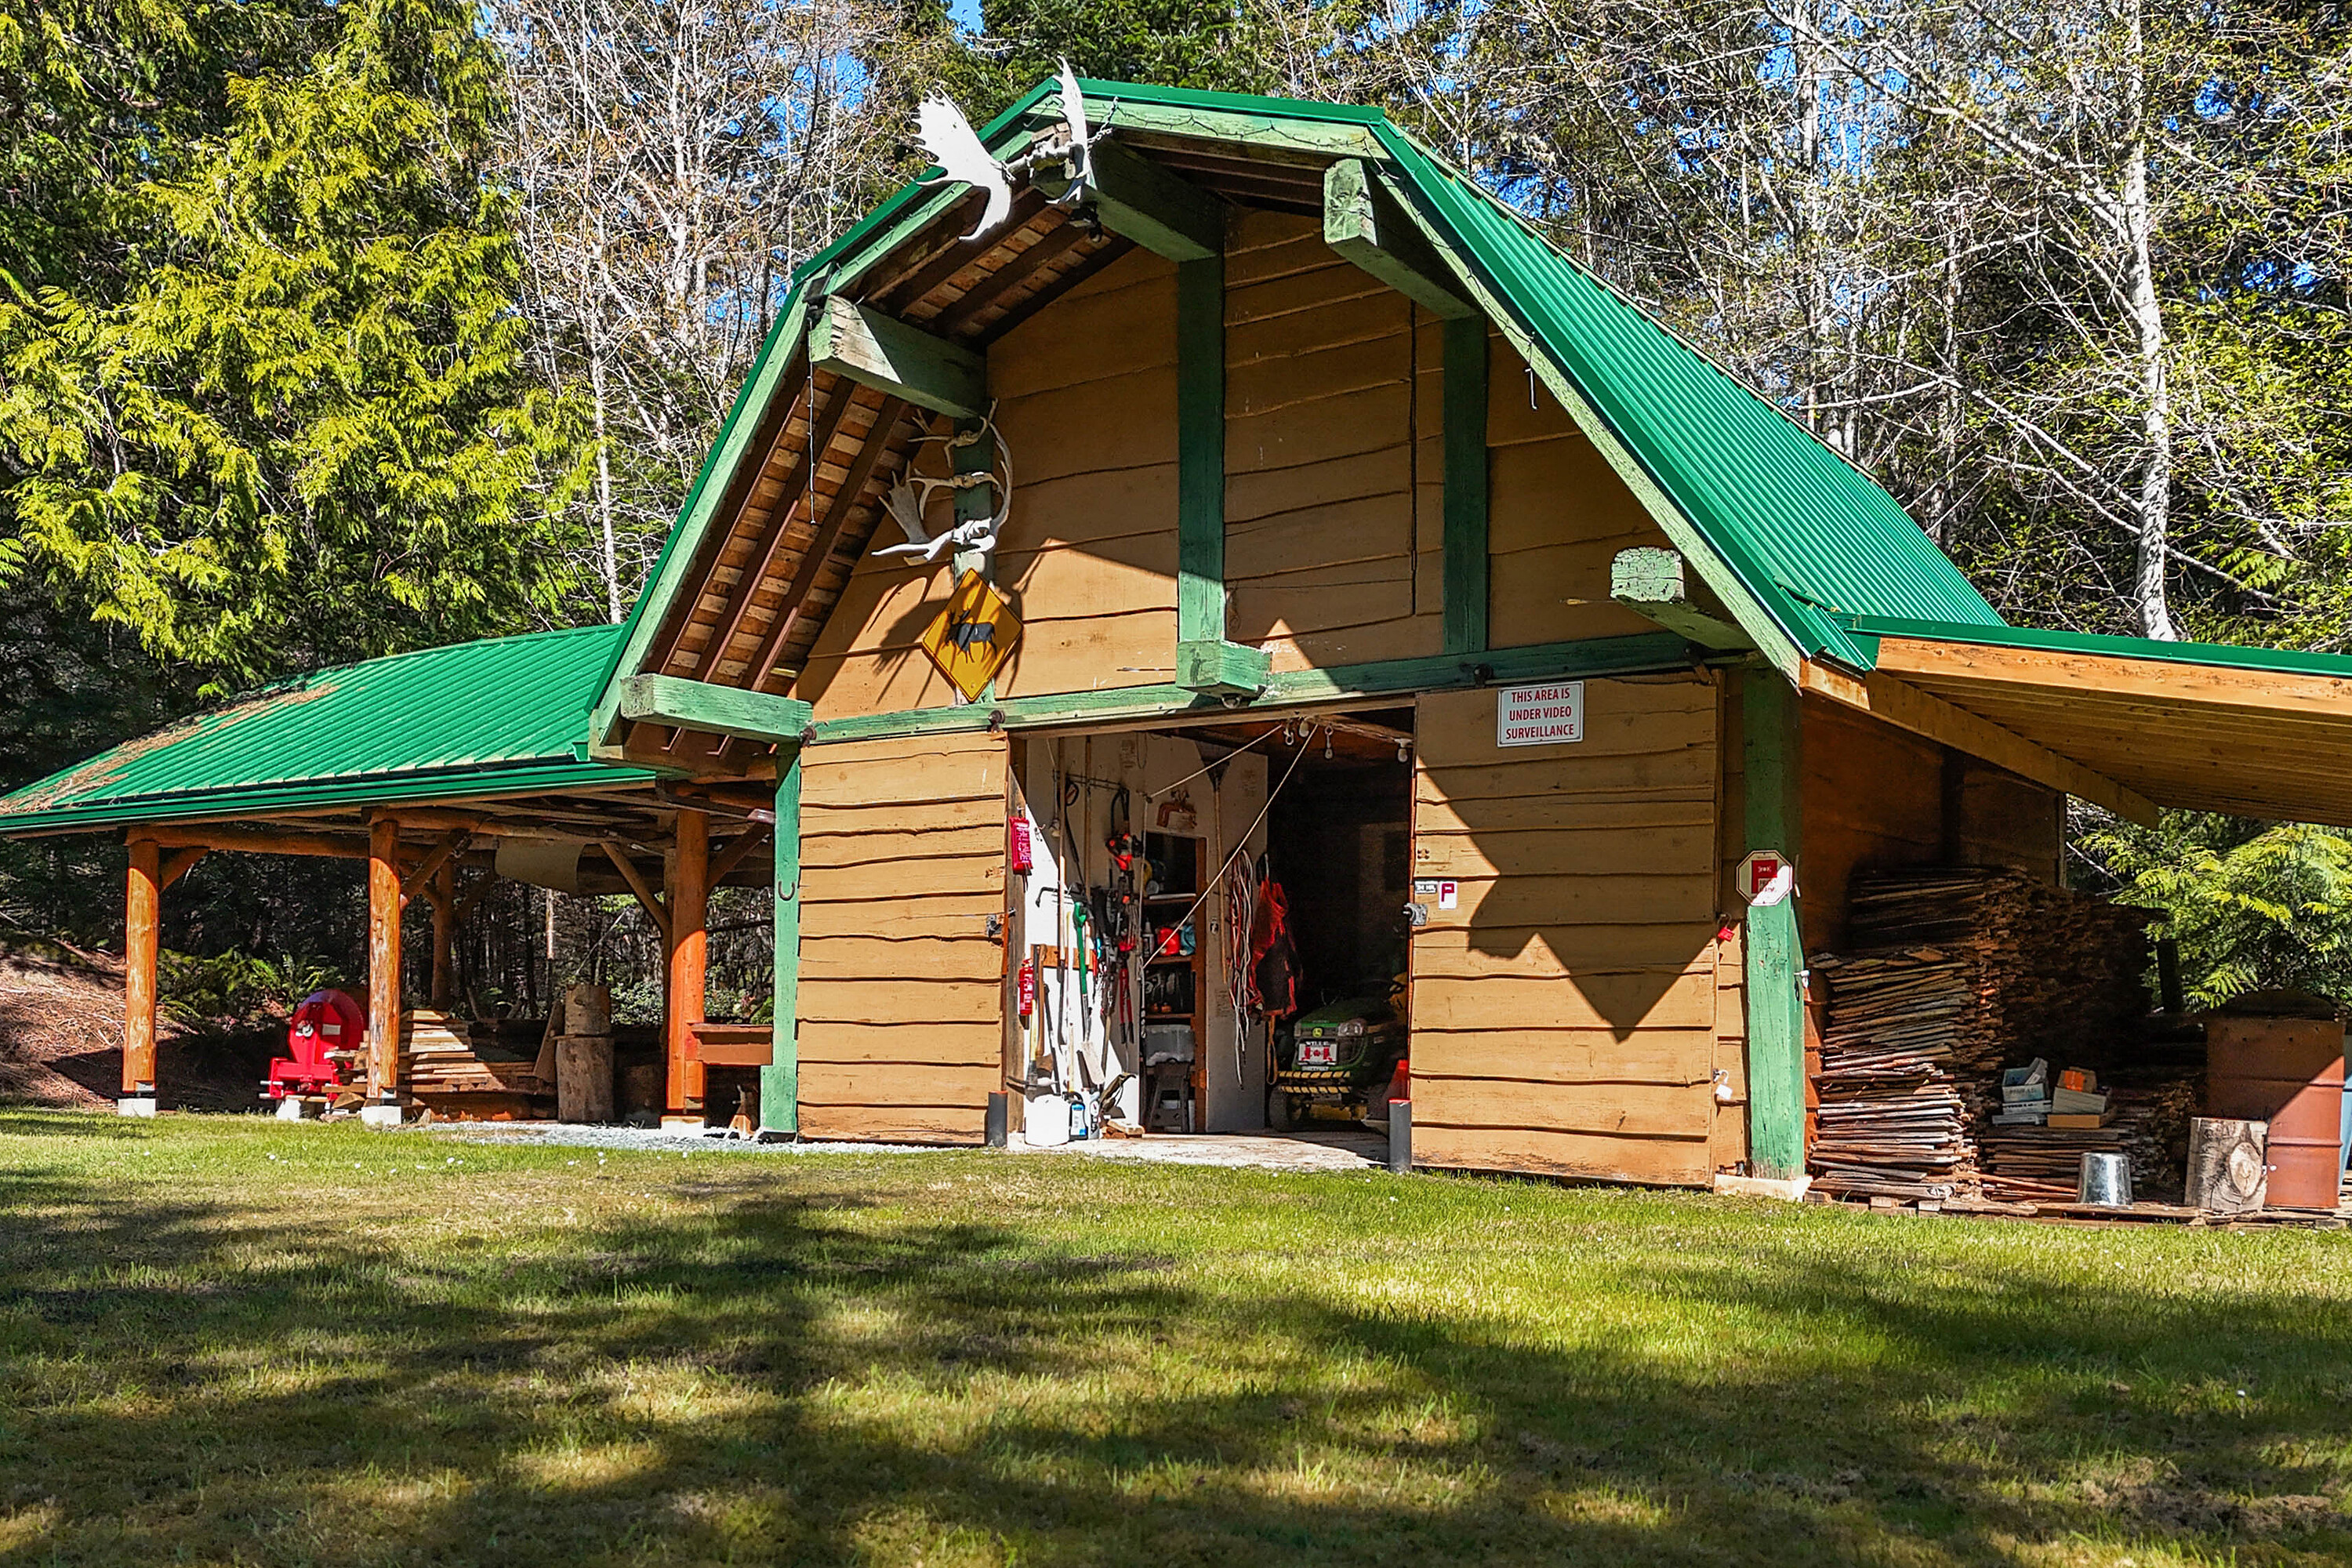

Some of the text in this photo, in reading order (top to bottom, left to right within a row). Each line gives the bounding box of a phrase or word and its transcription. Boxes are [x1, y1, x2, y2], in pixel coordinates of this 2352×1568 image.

[1512, 688, 1570, 702] THIS AREA IS
[1509, 706, 1572, 721] UNDER VIDEO
[1506, 724, 1574, 739] SURVEILLANCE
